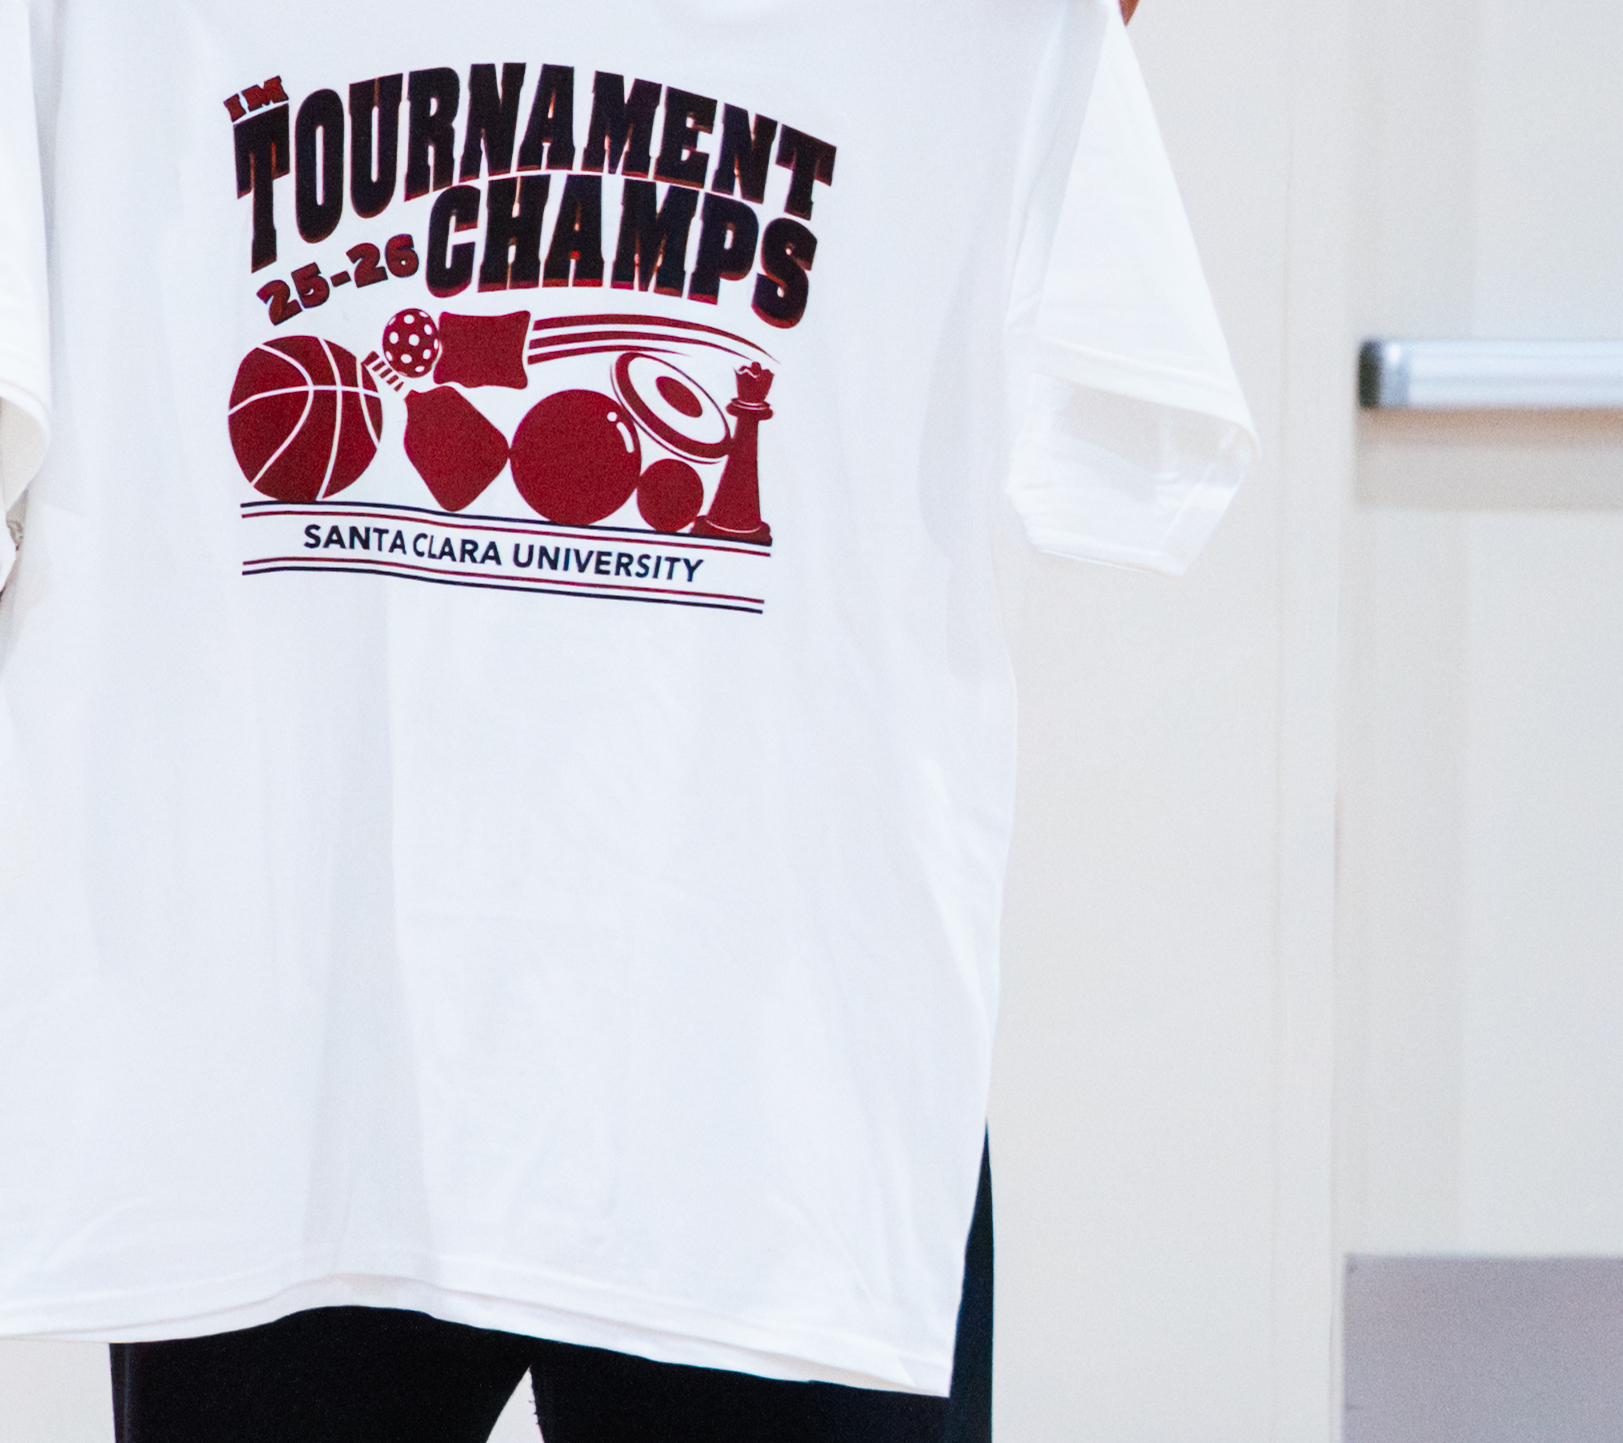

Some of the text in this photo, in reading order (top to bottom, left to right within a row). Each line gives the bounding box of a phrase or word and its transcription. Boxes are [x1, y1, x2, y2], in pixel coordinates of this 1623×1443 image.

[224, 75, 289, 122] IM
[232, 62, 837, 273] TOURNAMENT
[256, 173, 818, 329] 25-26 CHAMPS
[303, 524, 704, 583] SANTA CLARA UNIVERSITY
